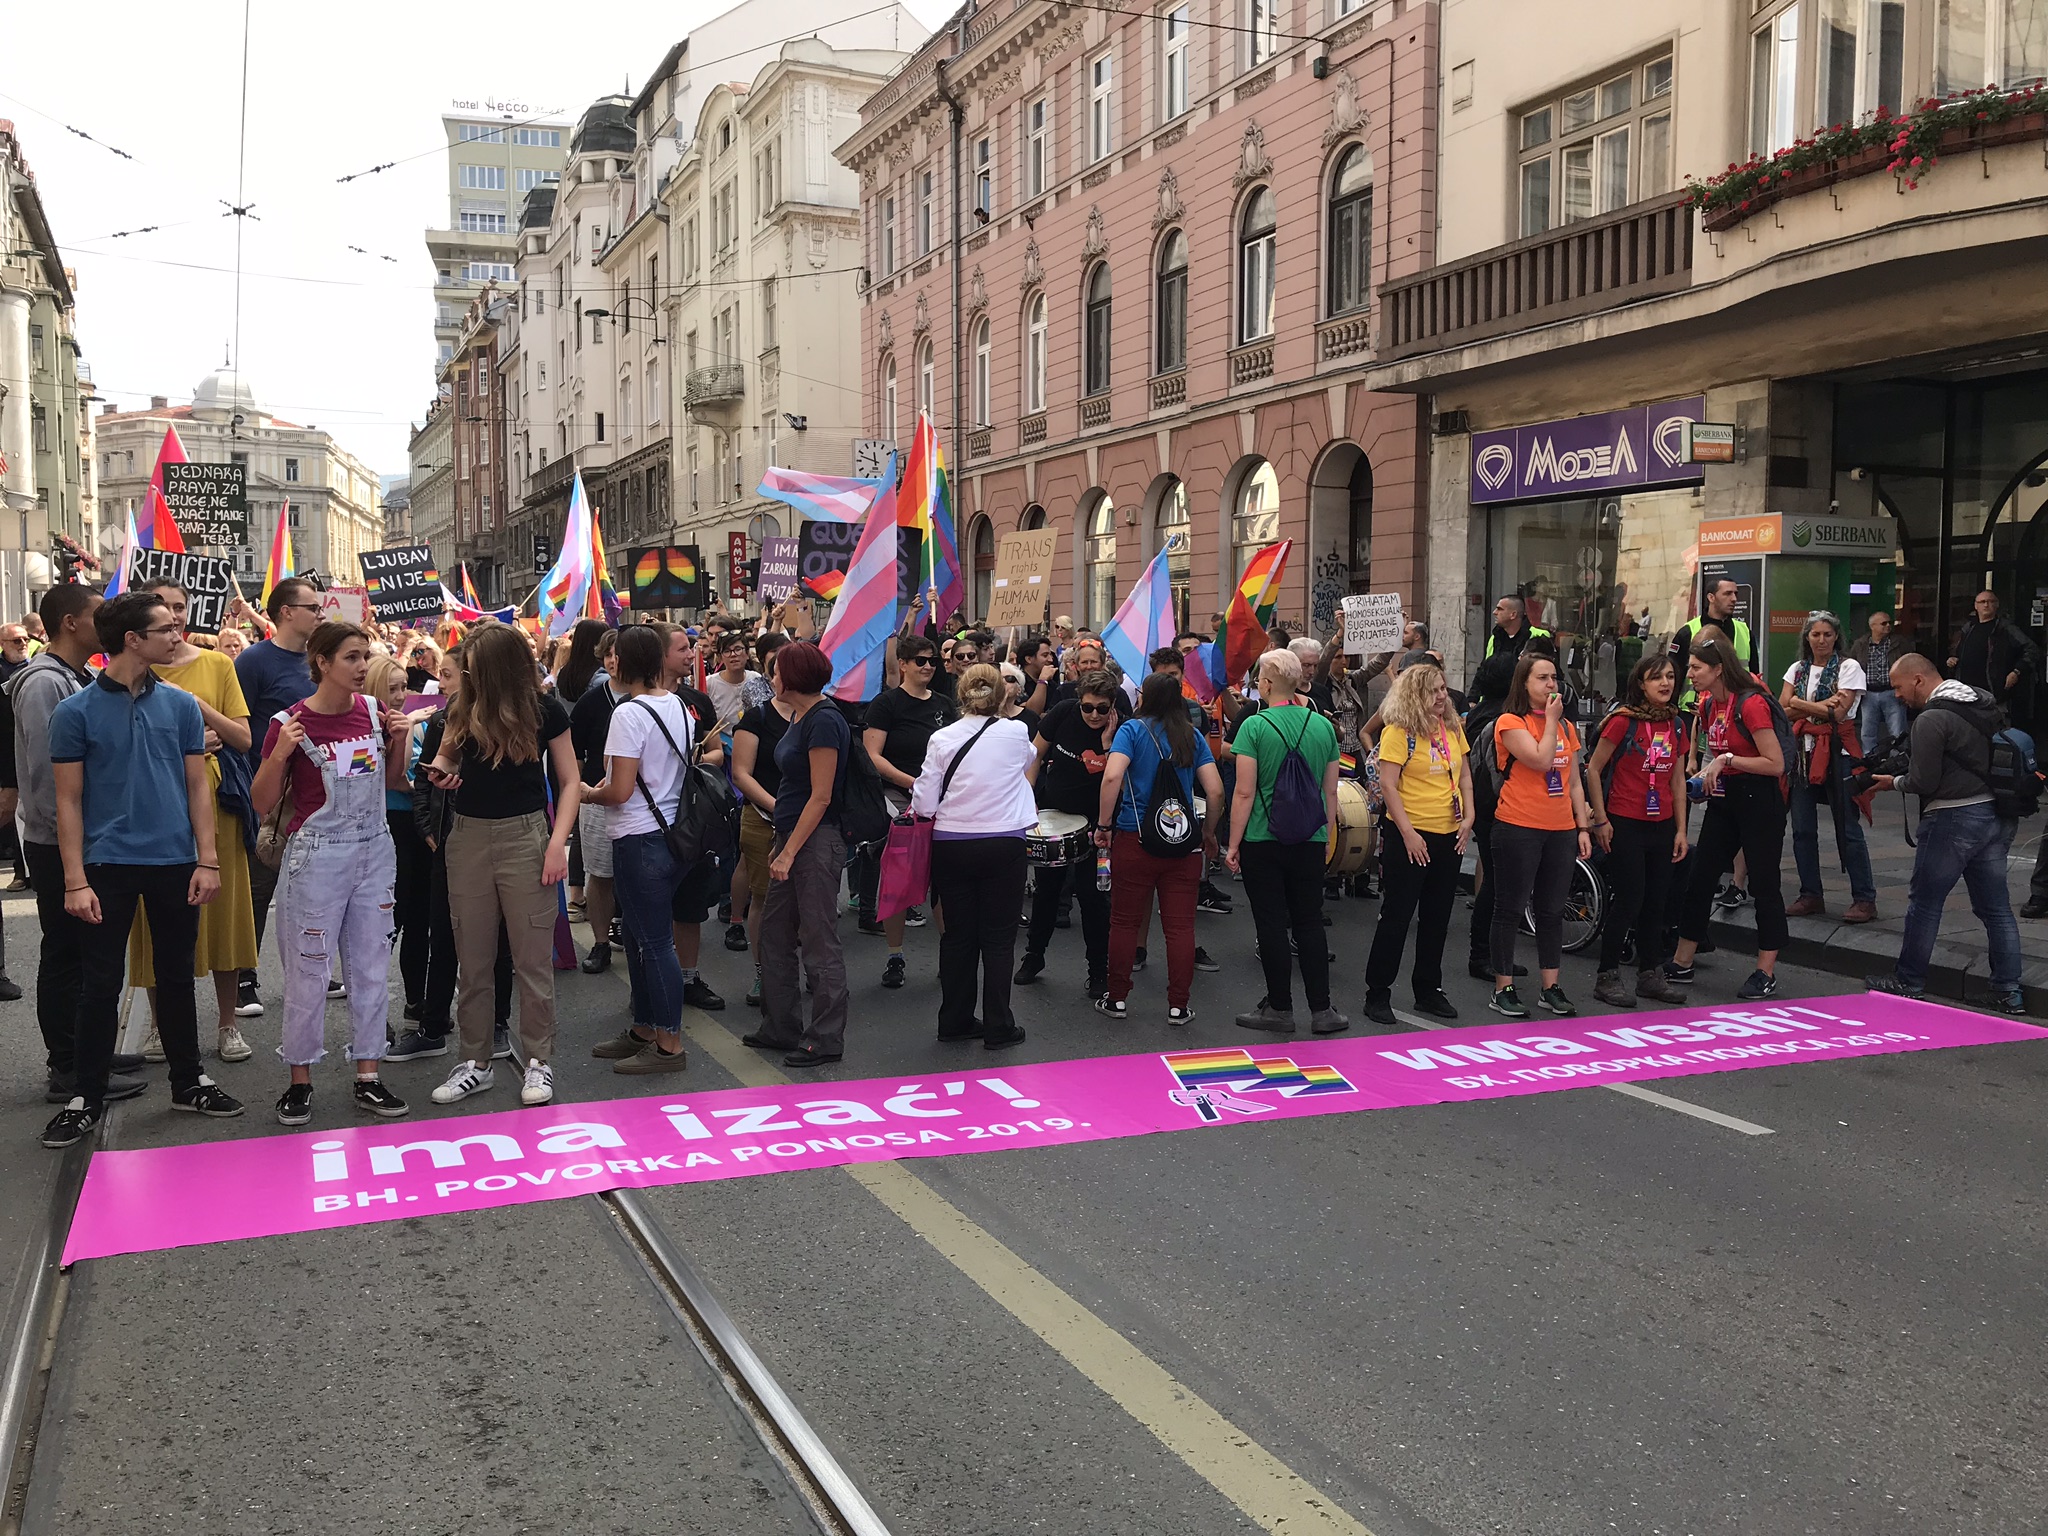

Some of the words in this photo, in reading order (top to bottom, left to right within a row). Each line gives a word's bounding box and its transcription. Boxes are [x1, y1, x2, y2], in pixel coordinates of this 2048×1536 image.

[452, 99, 479, 110] hotel
[1700, 430, 1732, 438] SBERBANK
[170, 465, 243, 481] JEDNAKA
[168, 481, 217, 494] PRAVA
[221, 482, 239, 495] ZA
[176, 522, 206, 534] RAVA
[208, 522, 231, 535] ZA
[1700, 528, 1754, 542] BANKOMAT
[1815, 525, 1887, 543] SBERBANK
[200, 533, 240, 545] TEBE!
[733, 537, 743, 575] AMKO
[1002, 538, 1052, 560] TRANS
[364, 548, 429, 570] LJUBAV
[130, 547, 231, 594] REFUGEES
[1011, 561, 1038, 576] rights
[380, 571, 428, 592] NIJE
[1012, 578, 1024, 586] are
[994, 588, 1040, 606] HUMAN
[375, 596, 444, 618] PRIVILEGIJA
[1001, 606, 1025, 625] rights
[1031, 843, 1042, 851] ZG
[1376, 1036, 1600, 1071] има
[1684, 1038, 1838, 1063] ПОНОСА
[1829, 1031, 1931, 1046] 2019.
[311, 1122, 628, 1183] ima
[313, 1187, 419, 1213] BH.
[435, 1151, 723, 1198] POVORKA
[729, 1129, 956, 1162] PONOSA
[957, 1117, 1092, 1140] 2019.
